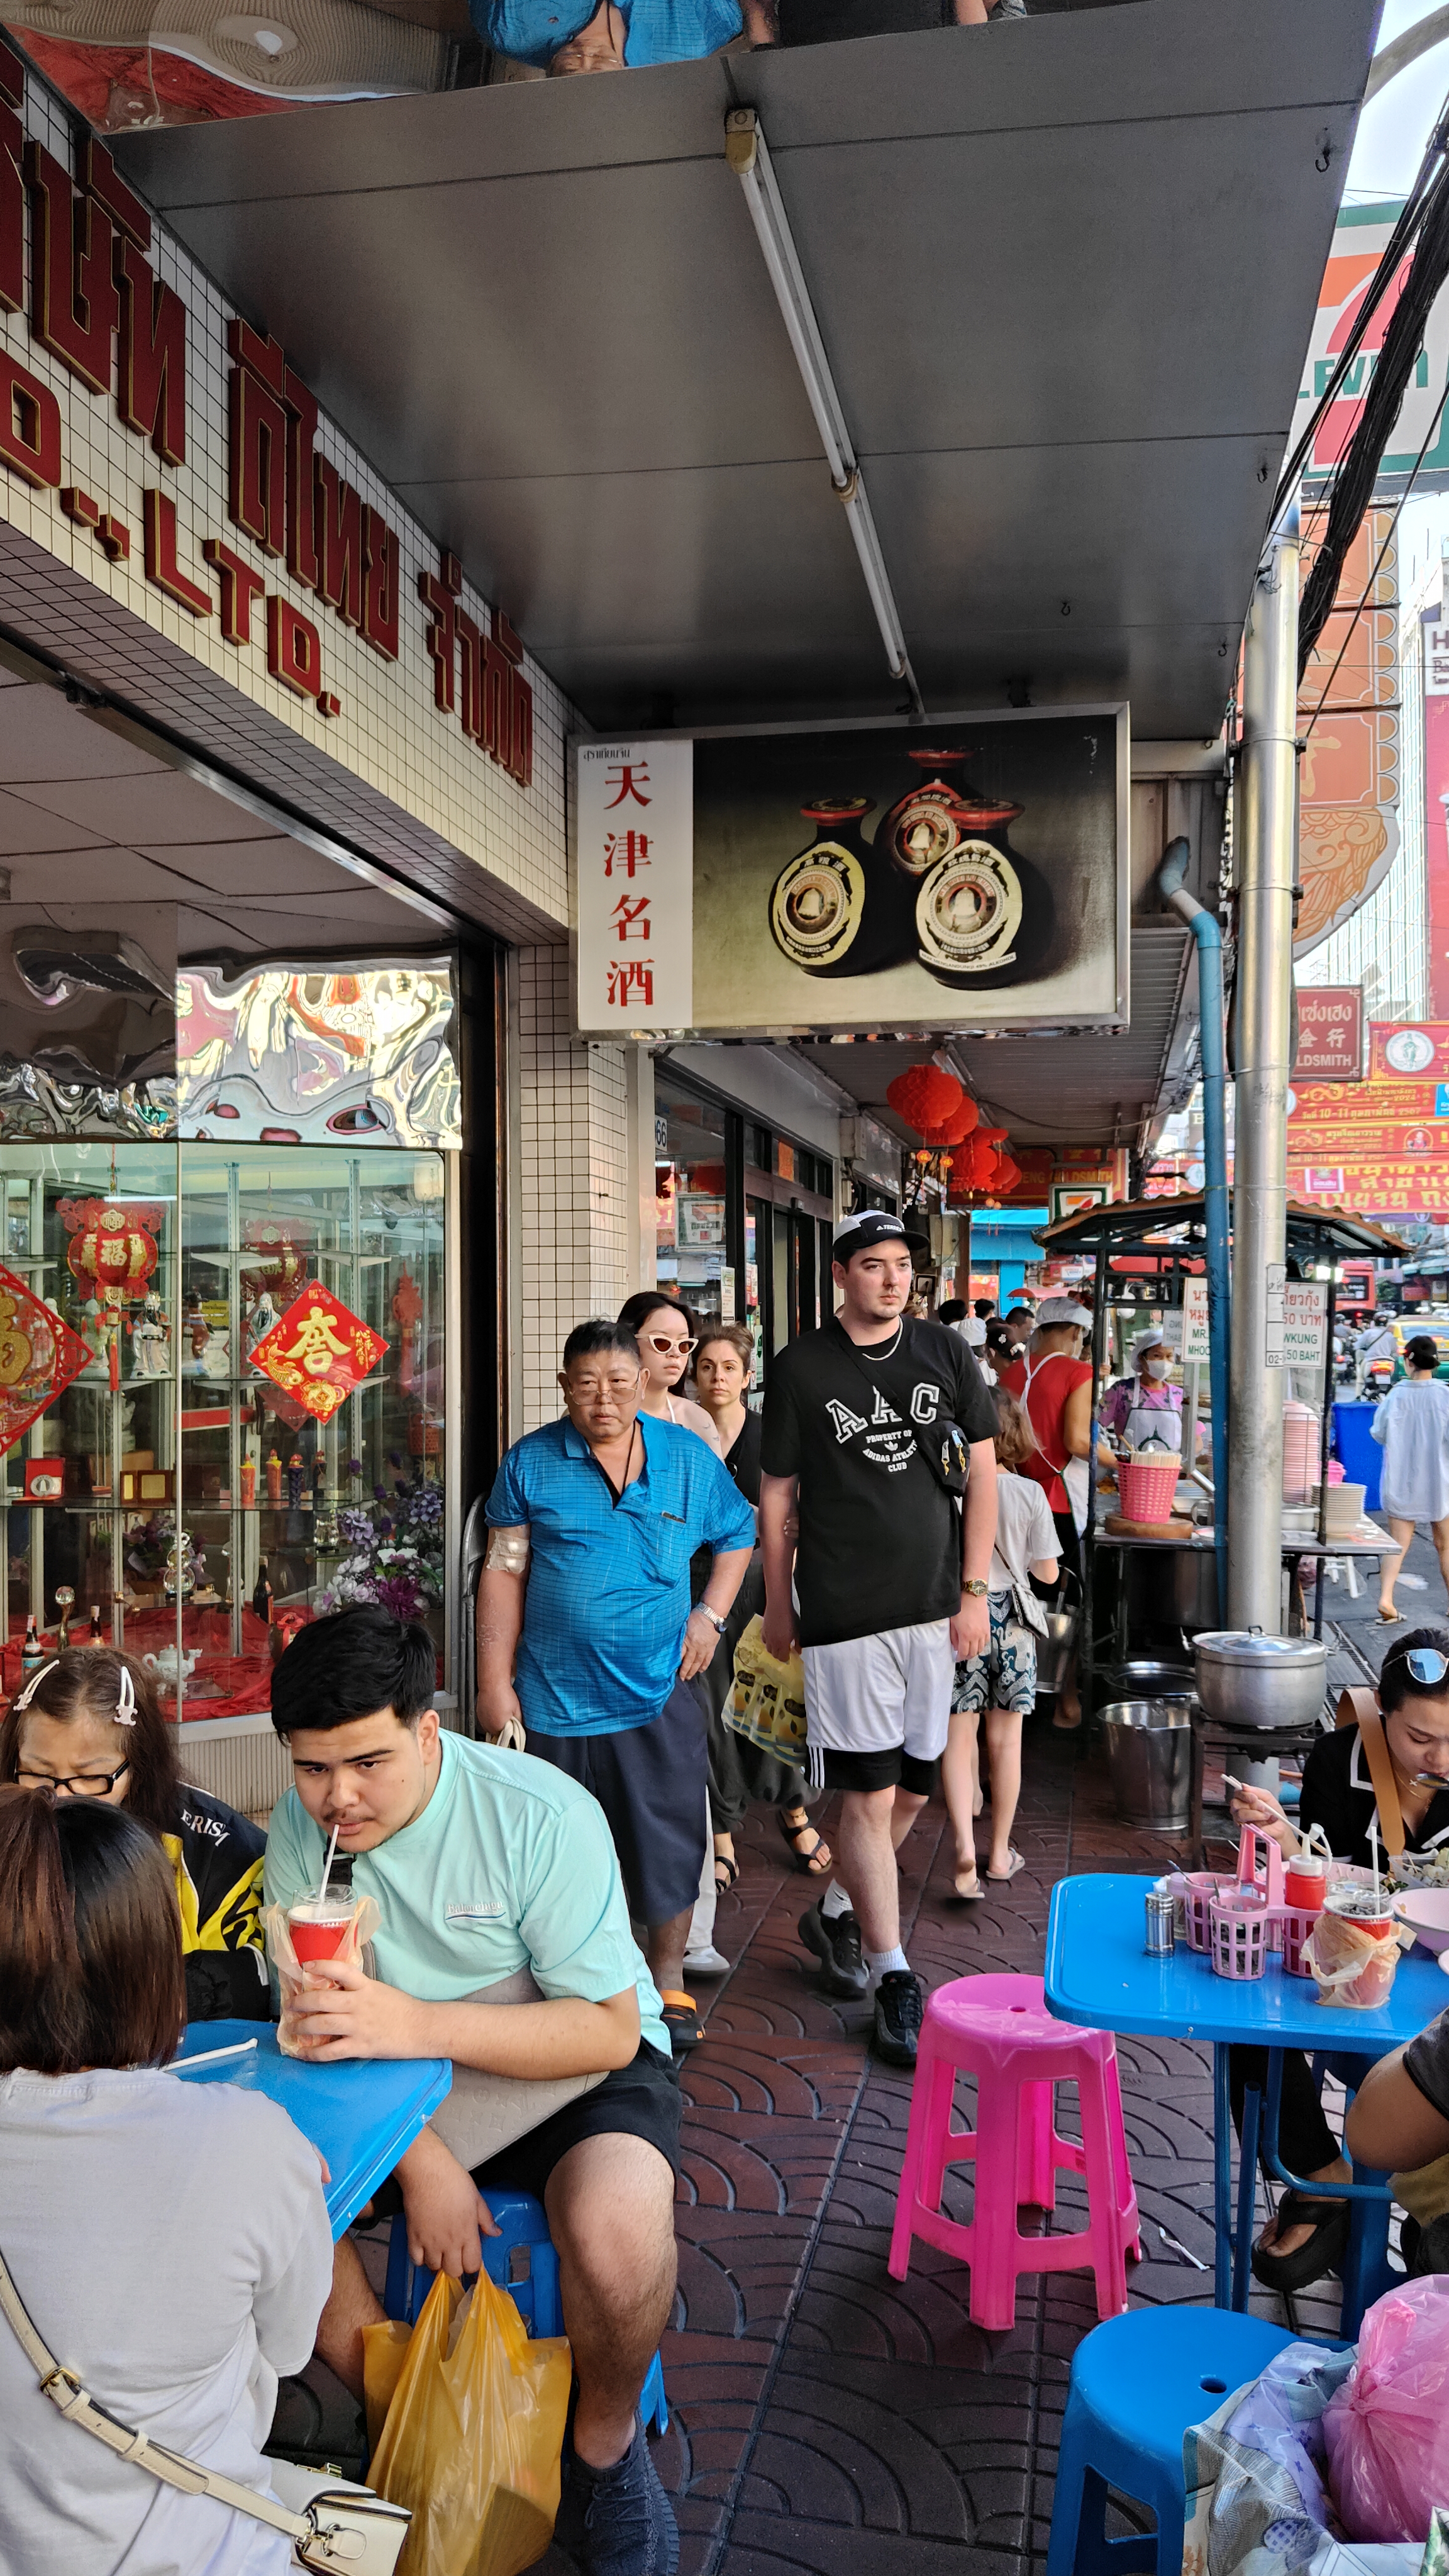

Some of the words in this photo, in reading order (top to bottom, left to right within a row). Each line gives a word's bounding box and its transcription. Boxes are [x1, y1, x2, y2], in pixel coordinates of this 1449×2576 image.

[655, 1119, 667, 1147] 66
[1300, 1314, 1321, 1326] บาท
[1287, 1350, 1297, 1360] 50
[1299, 1350, 1320, 1362] BAHT
[865, 1431, 902, 1444] PROPERTY
[902, 1429, 913, 1437] OF
[862, 1448, 891, 1463] ADIDAS
[887, 1462, 908, 1473] CLUB
